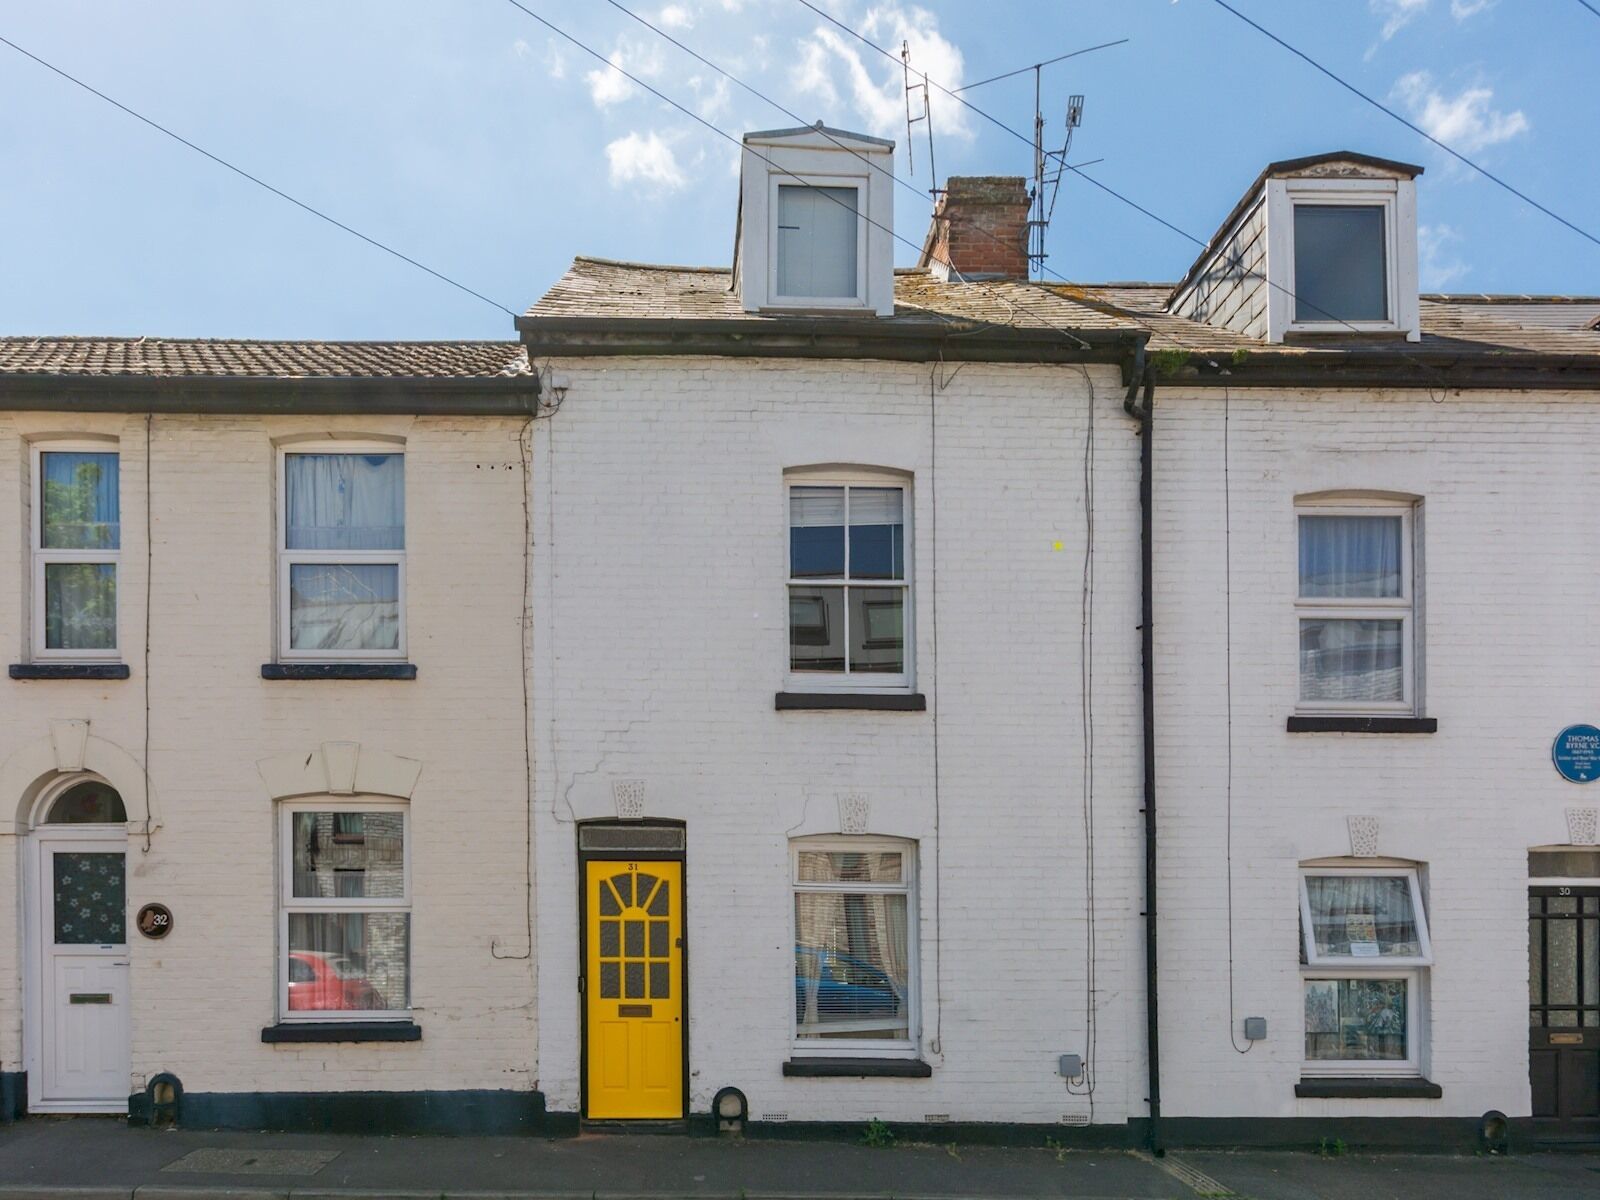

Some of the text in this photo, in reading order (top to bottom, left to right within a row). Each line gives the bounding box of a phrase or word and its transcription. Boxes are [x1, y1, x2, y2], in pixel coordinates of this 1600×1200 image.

[628, 863, 638, 871] 31
[1559, 887, 1570, 896] 30
[153, 914, 168, 925] 32
